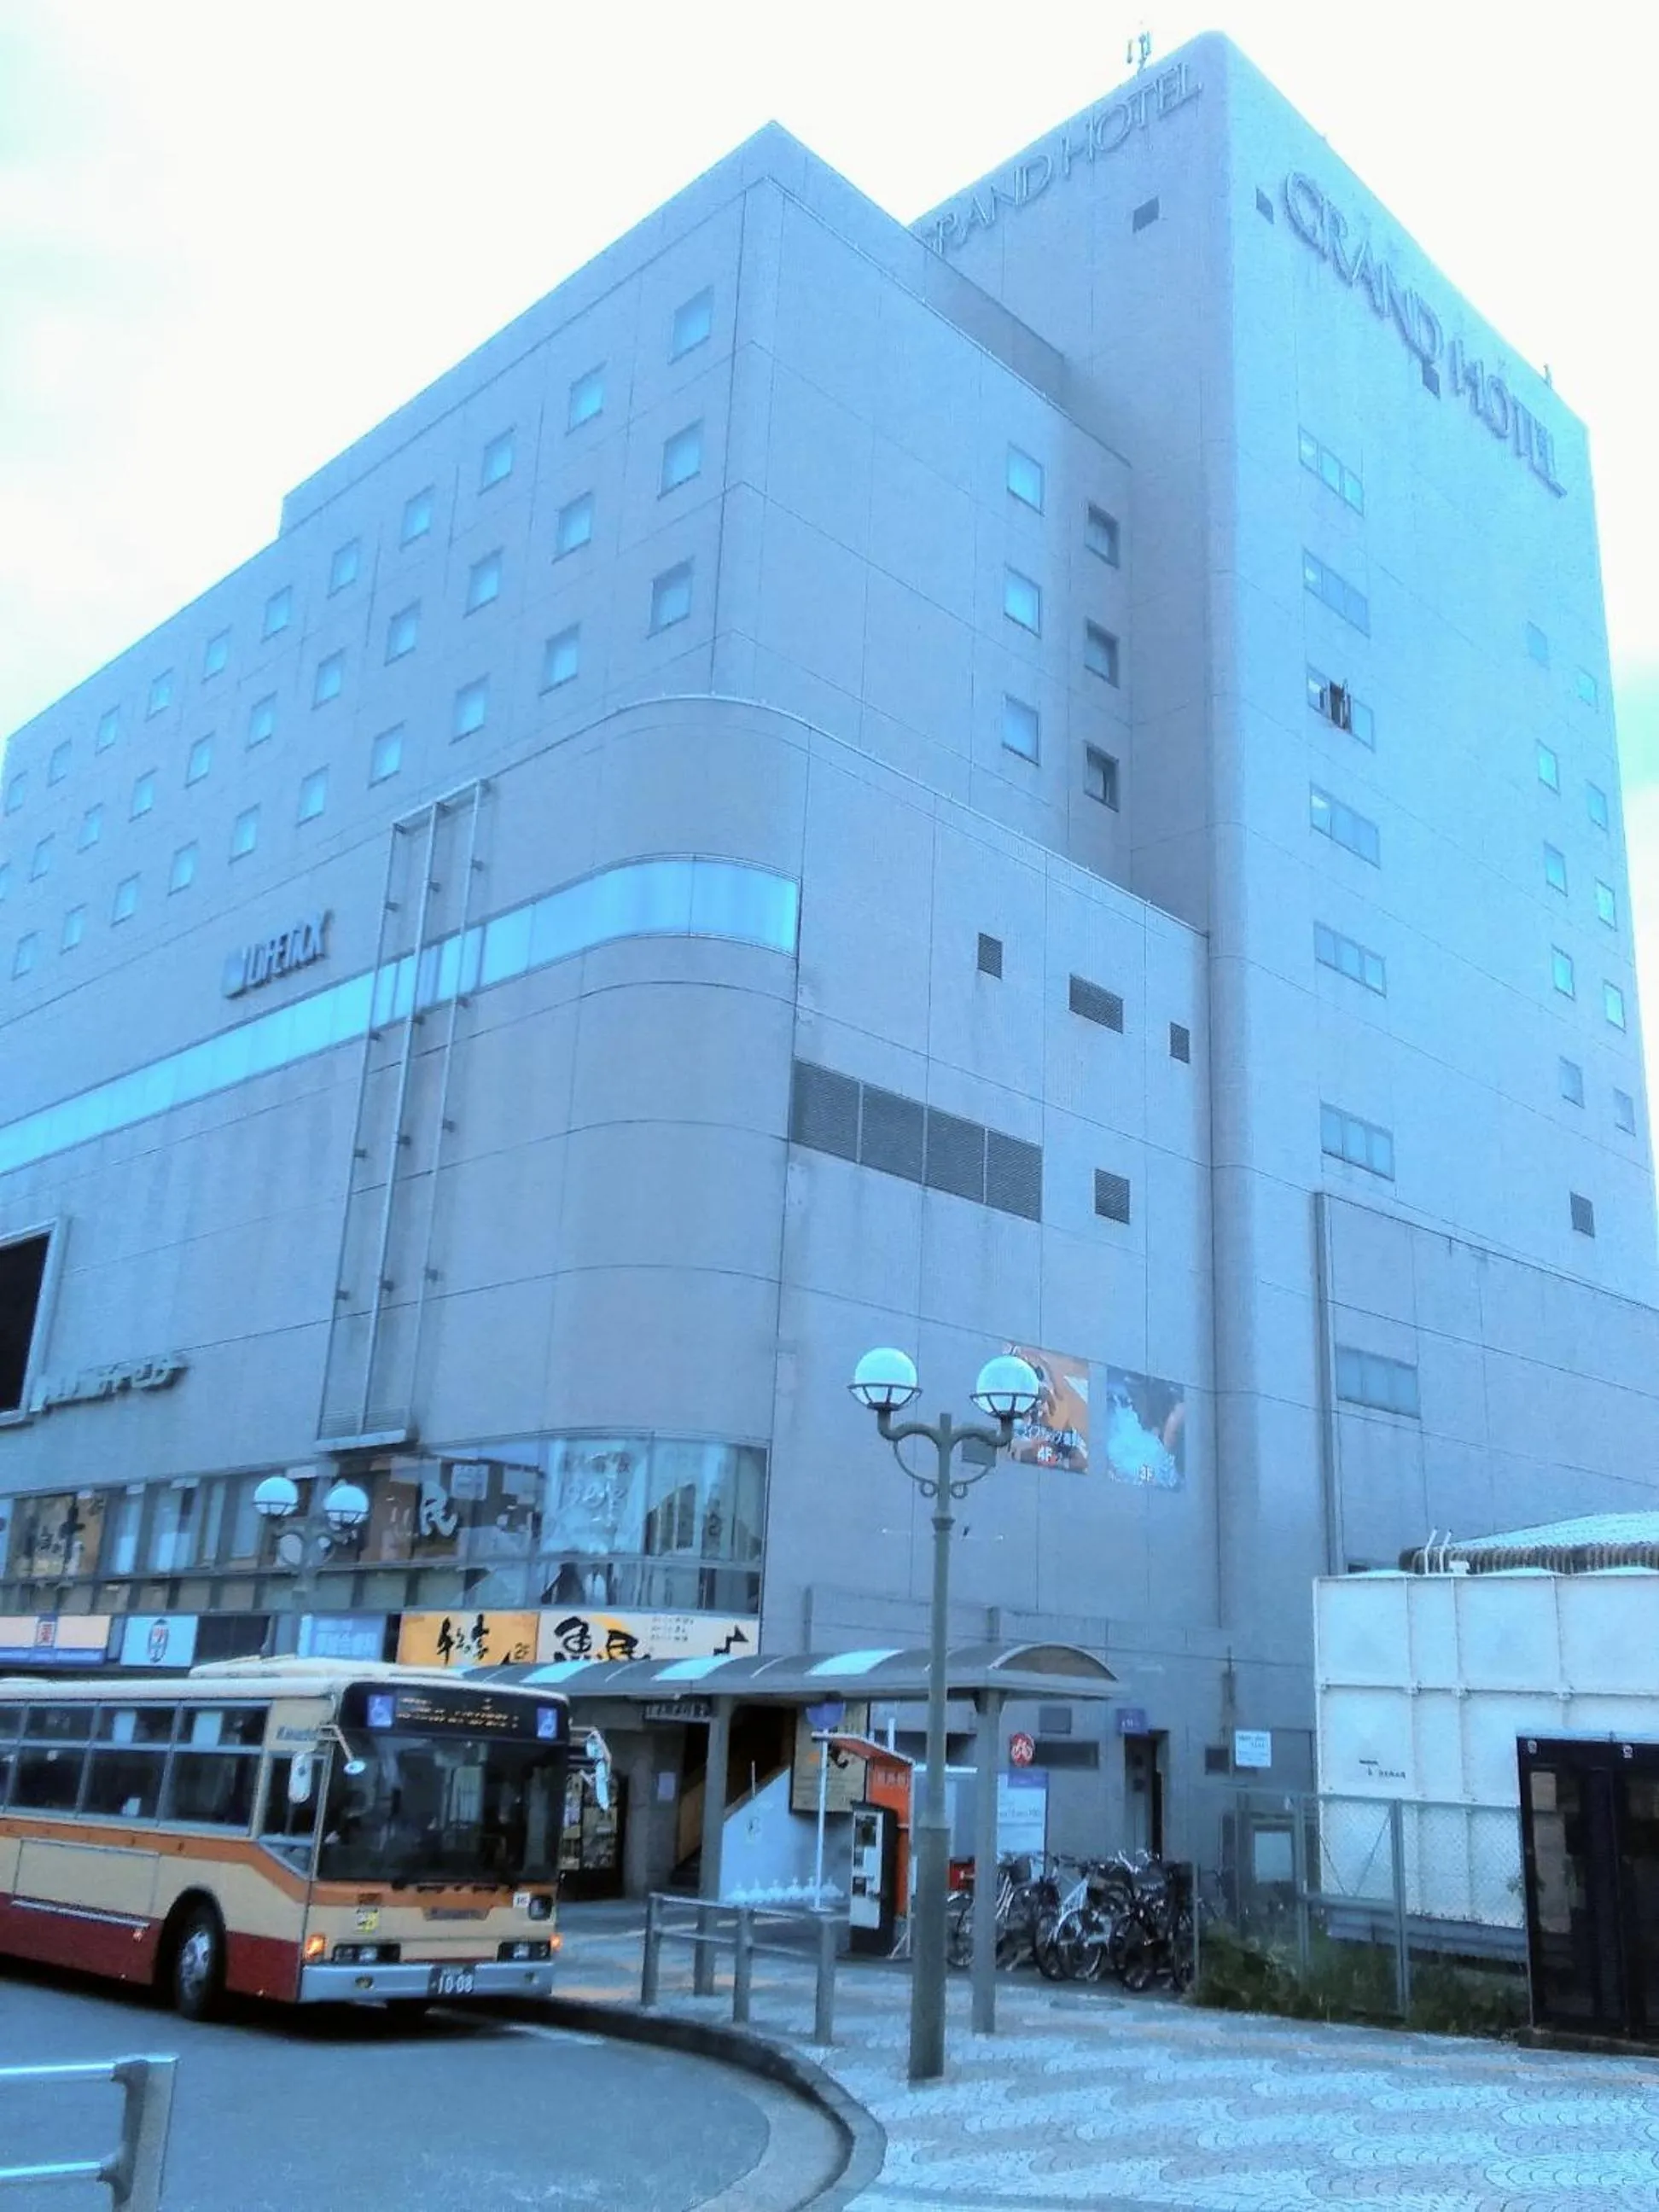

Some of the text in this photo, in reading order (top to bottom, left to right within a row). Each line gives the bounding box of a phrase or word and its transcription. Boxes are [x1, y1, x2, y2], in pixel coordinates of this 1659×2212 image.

[923, 61, 1204, 256] RAND HOTEL
[1284, 172, 1568, 500] GRAND HOTEL
[552, 1615, 651, 1663] 魚民
